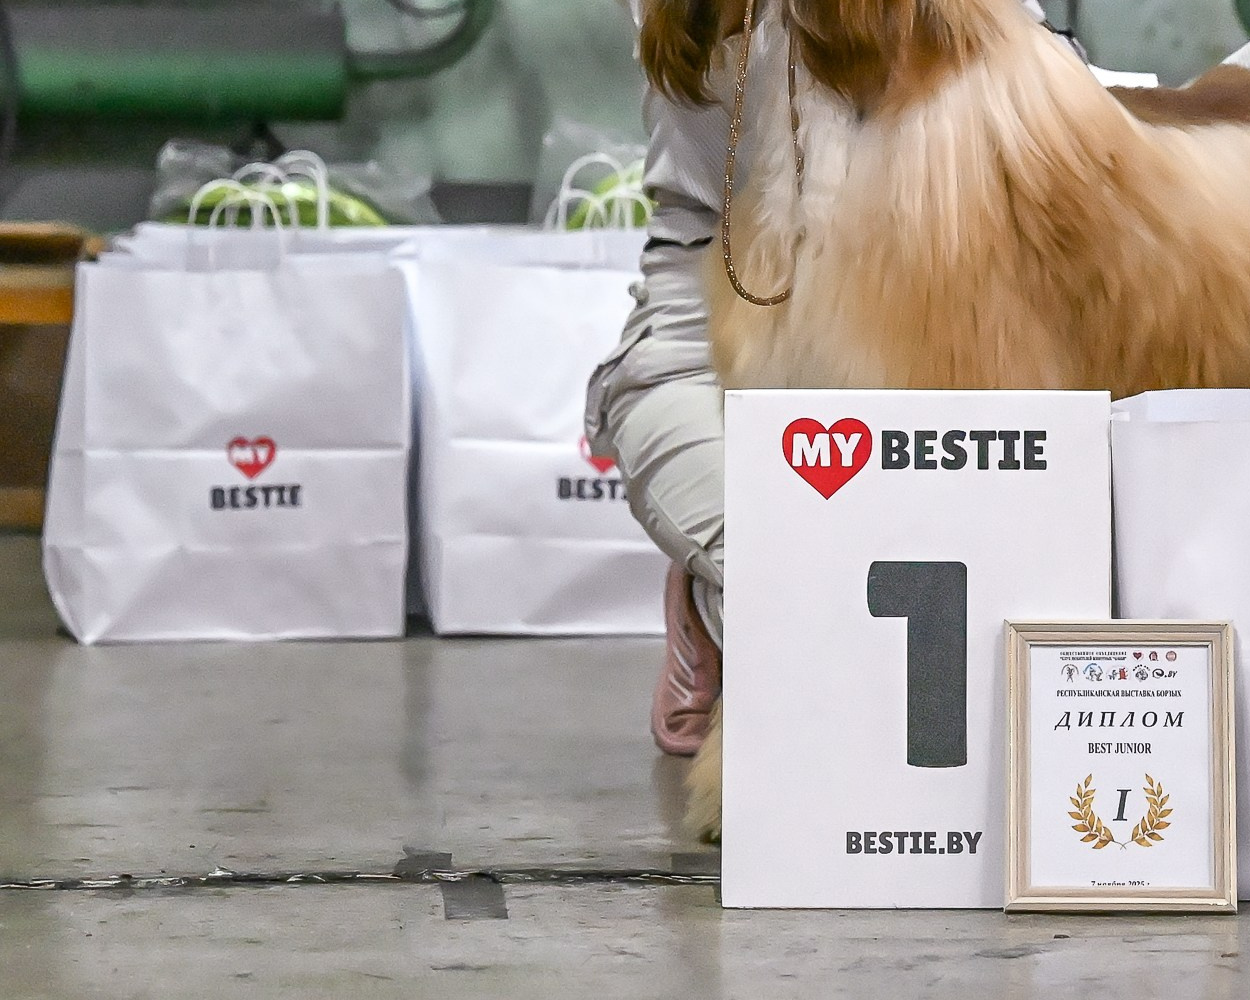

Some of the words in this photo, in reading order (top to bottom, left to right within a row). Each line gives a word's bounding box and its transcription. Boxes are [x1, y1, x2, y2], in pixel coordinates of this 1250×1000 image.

[792, 432, 862, 468] MY
[881, 430, 1048, 470] BESTIE
[210, 484, 302, 509] BESTIE
[558, 478, 628, 500] BEST
[867, 560, 968, 769] 1
[1056, 689, 1120, 698] РЕСПУБЛИКАНСКАЯ
[1121, 689, 1155, 698] ВЫСТАВКА
[1156, 689, 1182, 698] БОРЗЫХ
[1054, 711, 1185, 731] ДИПЛОМ
[1088, 742, 1112, 754] BEST
[1115, 742, 1152, 754] JUNIOR
[1112, 789, 1132, 821] I
[845, 831, 983, 855] BESTIE.BY
